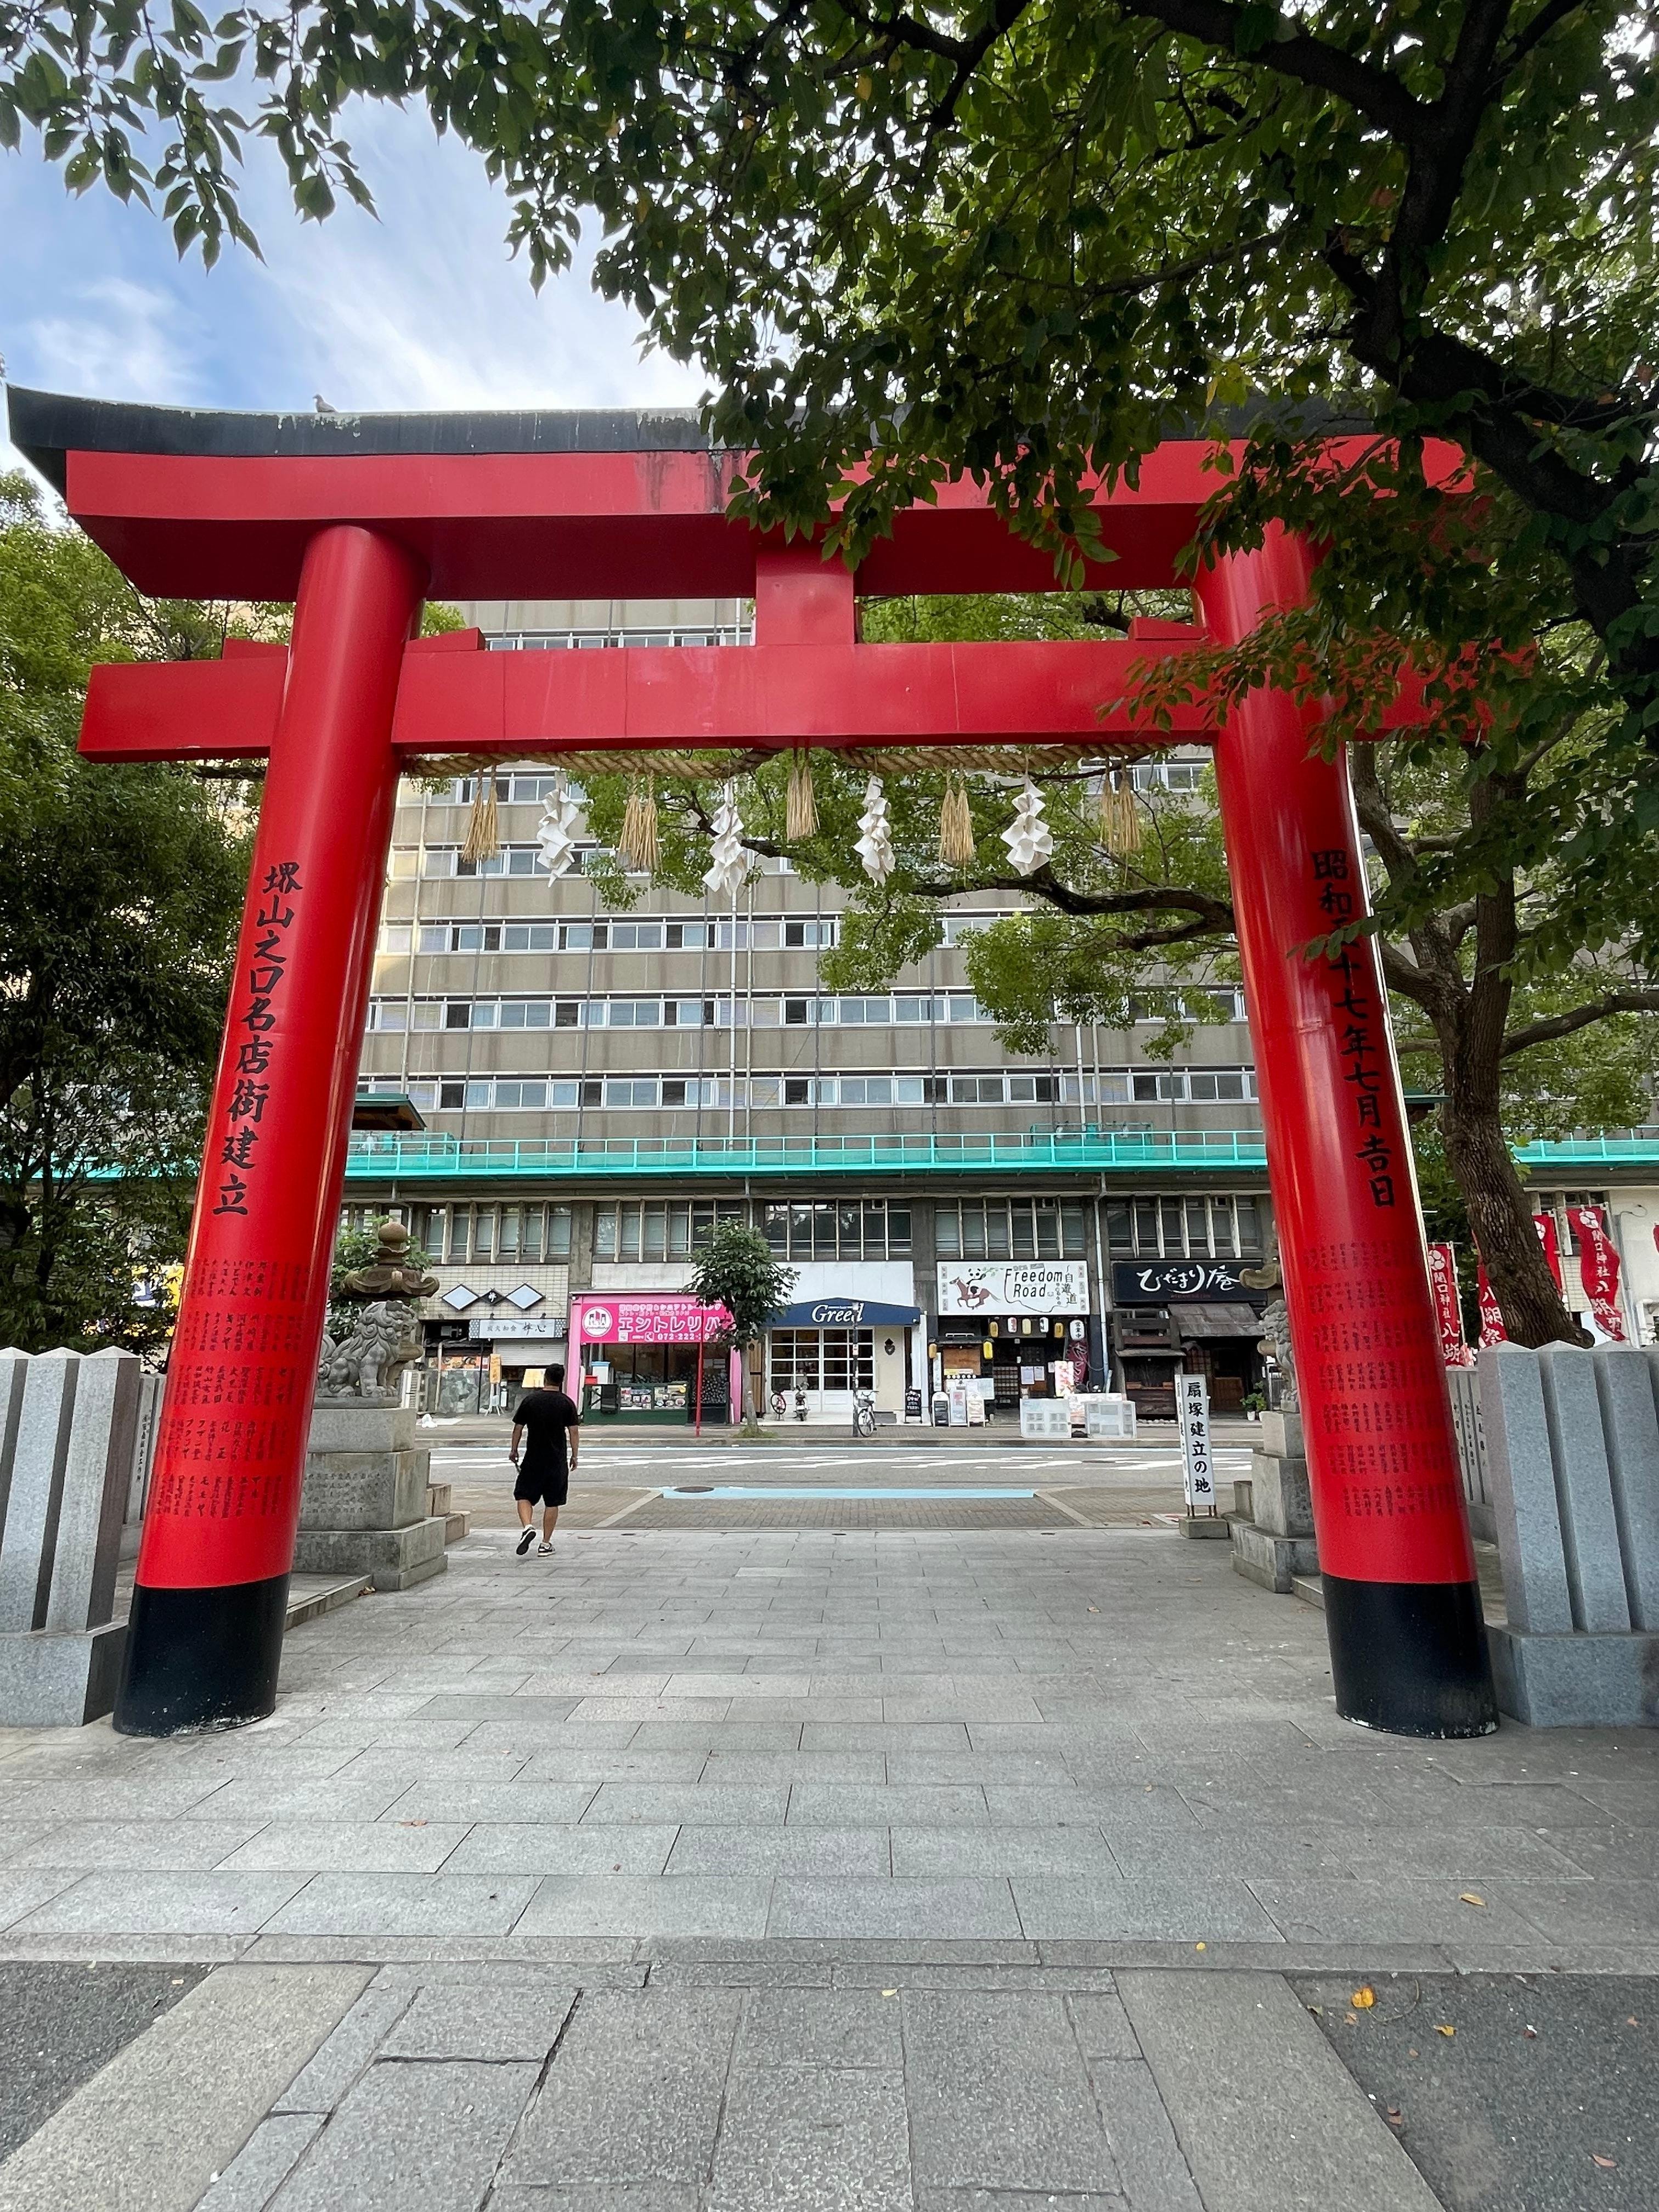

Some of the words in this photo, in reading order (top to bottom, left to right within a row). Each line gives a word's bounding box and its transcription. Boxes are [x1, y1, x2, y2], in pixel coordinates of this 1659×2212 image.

[212, 861, 303, 1216] 堺山之口名店街建立
[1005, 1268, 1063, 1282] Freedom
[1013, 1283, 1046, 1297] Road
[1187, 1382, 1211, 1493] 扇塚建立の地
